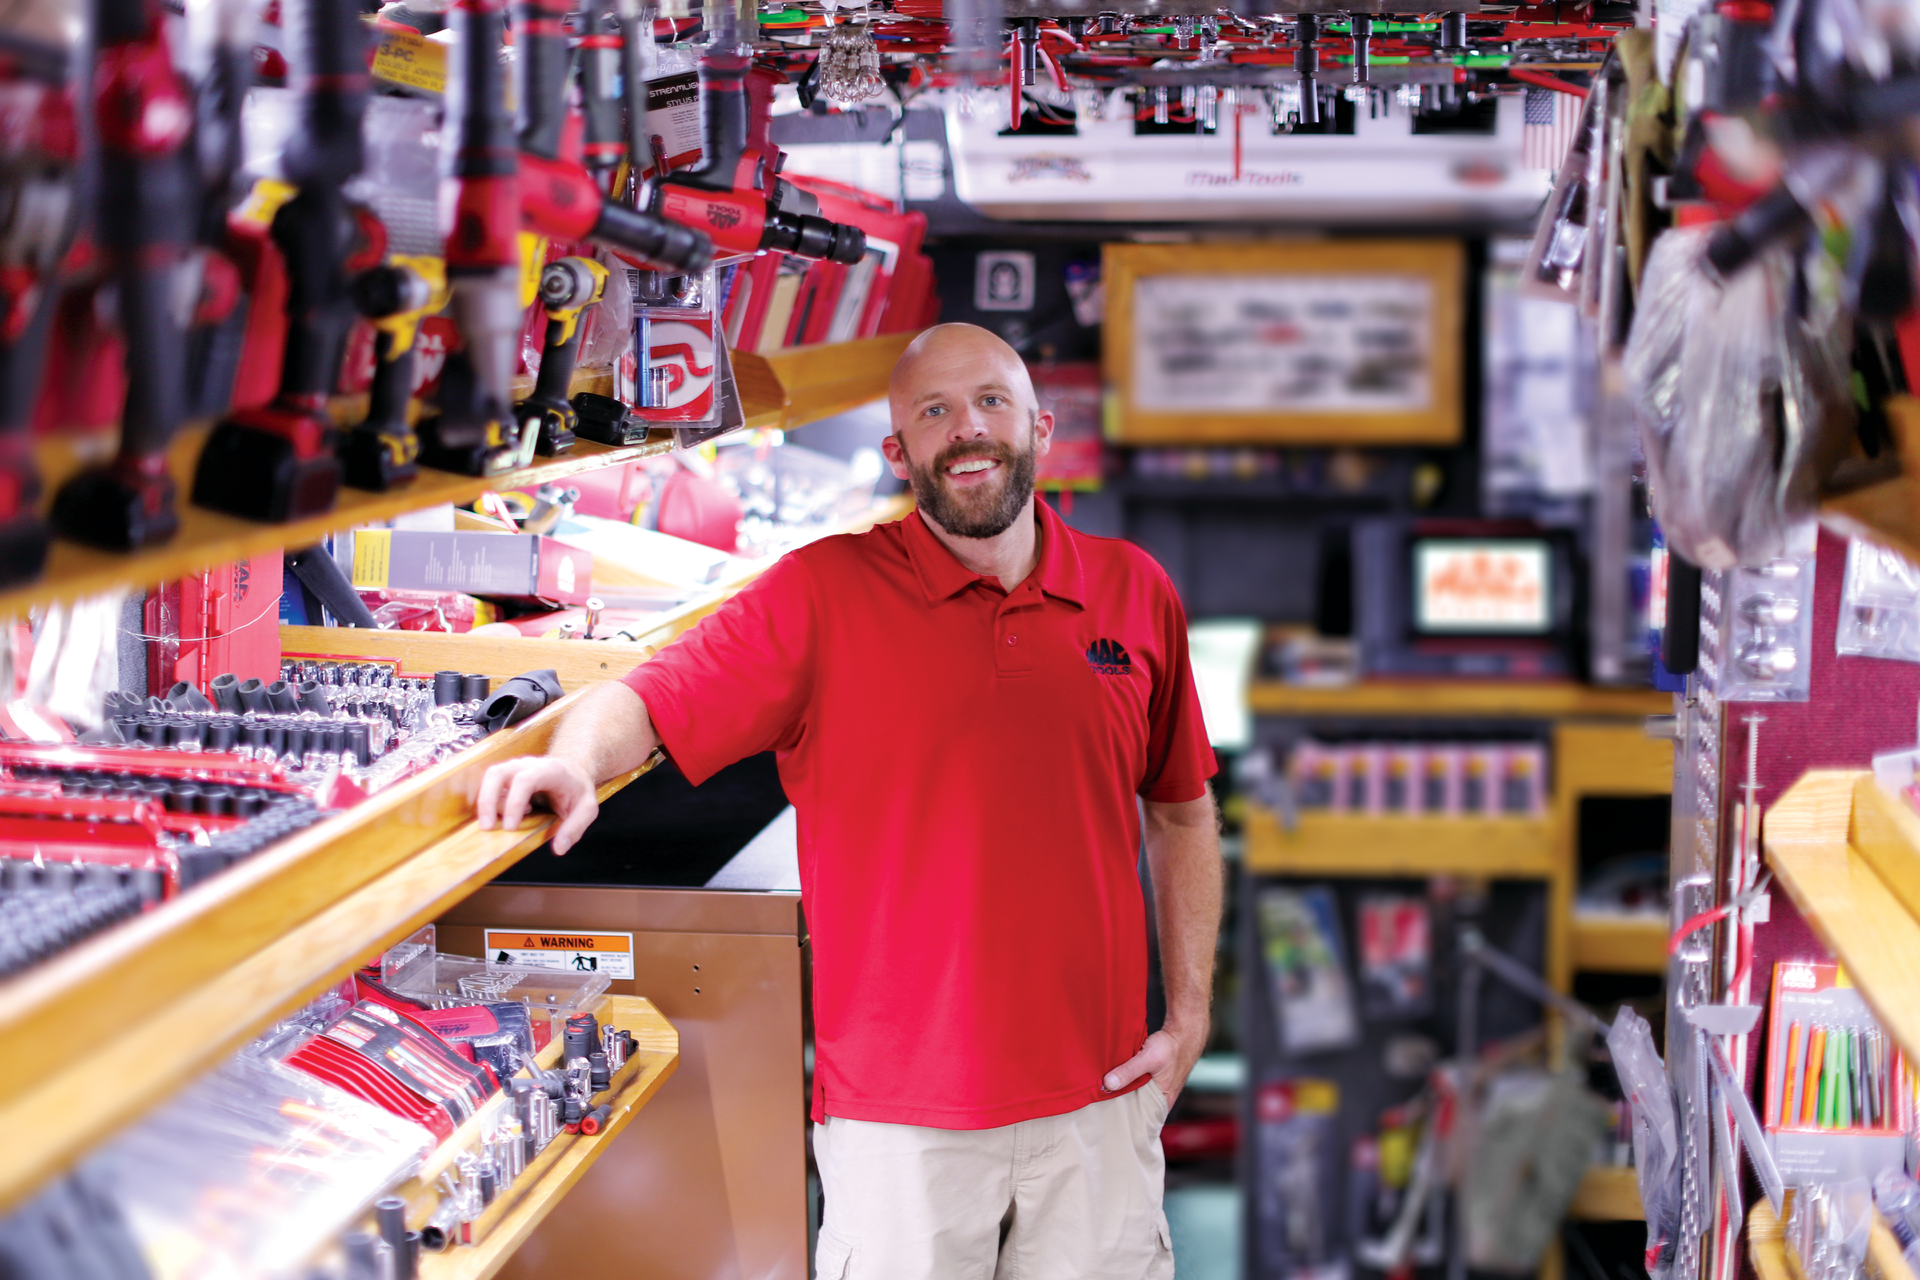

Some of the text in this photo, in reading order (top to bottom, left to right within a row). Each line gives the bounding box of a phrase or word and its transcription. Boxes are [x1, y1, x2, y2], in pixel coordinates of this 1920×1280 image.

[649, 82, 700, 98] STREAMLIGH
[666, 97, 693, 108] STYLUS
[707, 203, 742, 217] TOOLS
[1086, 638, 1131, 666] MAC
[1090, 665, 1131, 675] TOOLS
[540, 937, 594, 949] WARNING
[395, 955, 405, 970] Solid
